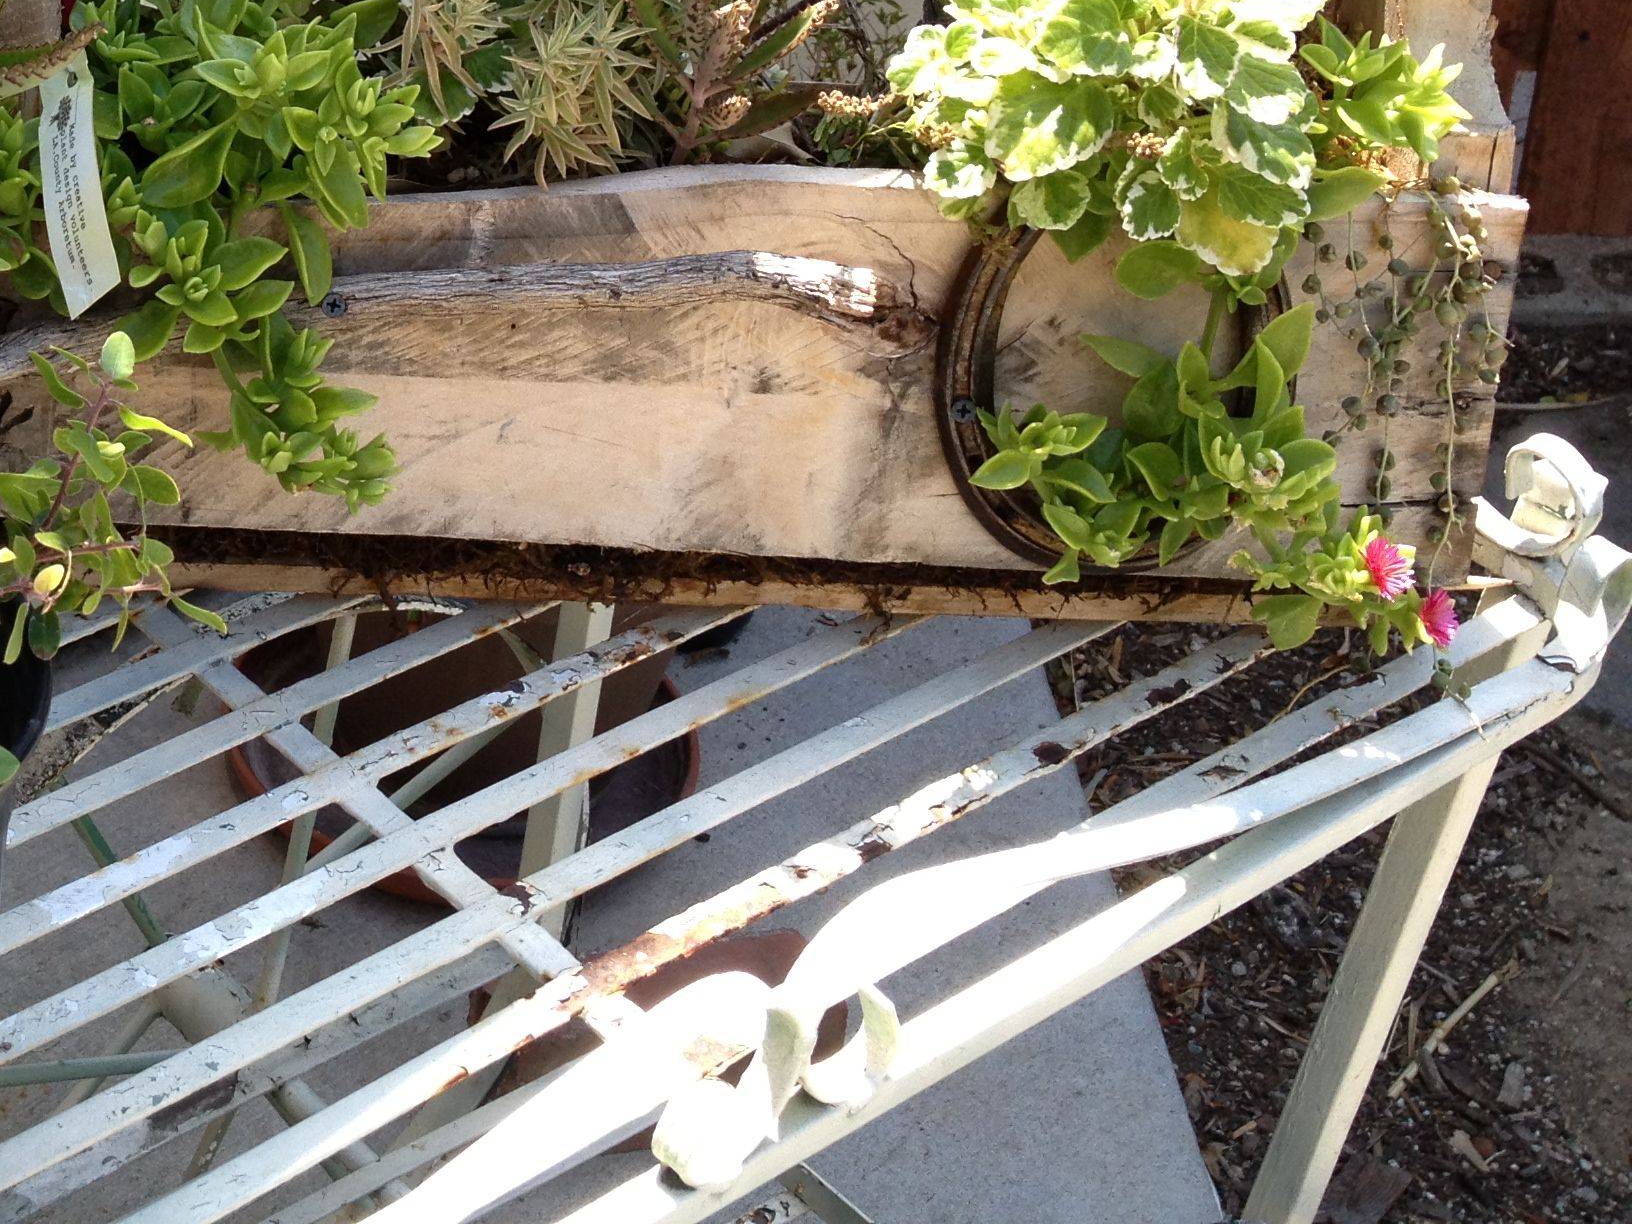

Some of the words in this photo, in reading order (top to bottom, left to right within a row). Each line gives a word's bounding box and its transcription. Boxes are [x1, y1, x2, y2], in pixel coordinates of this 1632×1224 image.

[59, 129, 69, 162] plant
[68, 122, 77, 149] Made
[69, 154, 78, 169] by
[62, 167, 74, 209] design
[71, 174, 87, 231] creative
